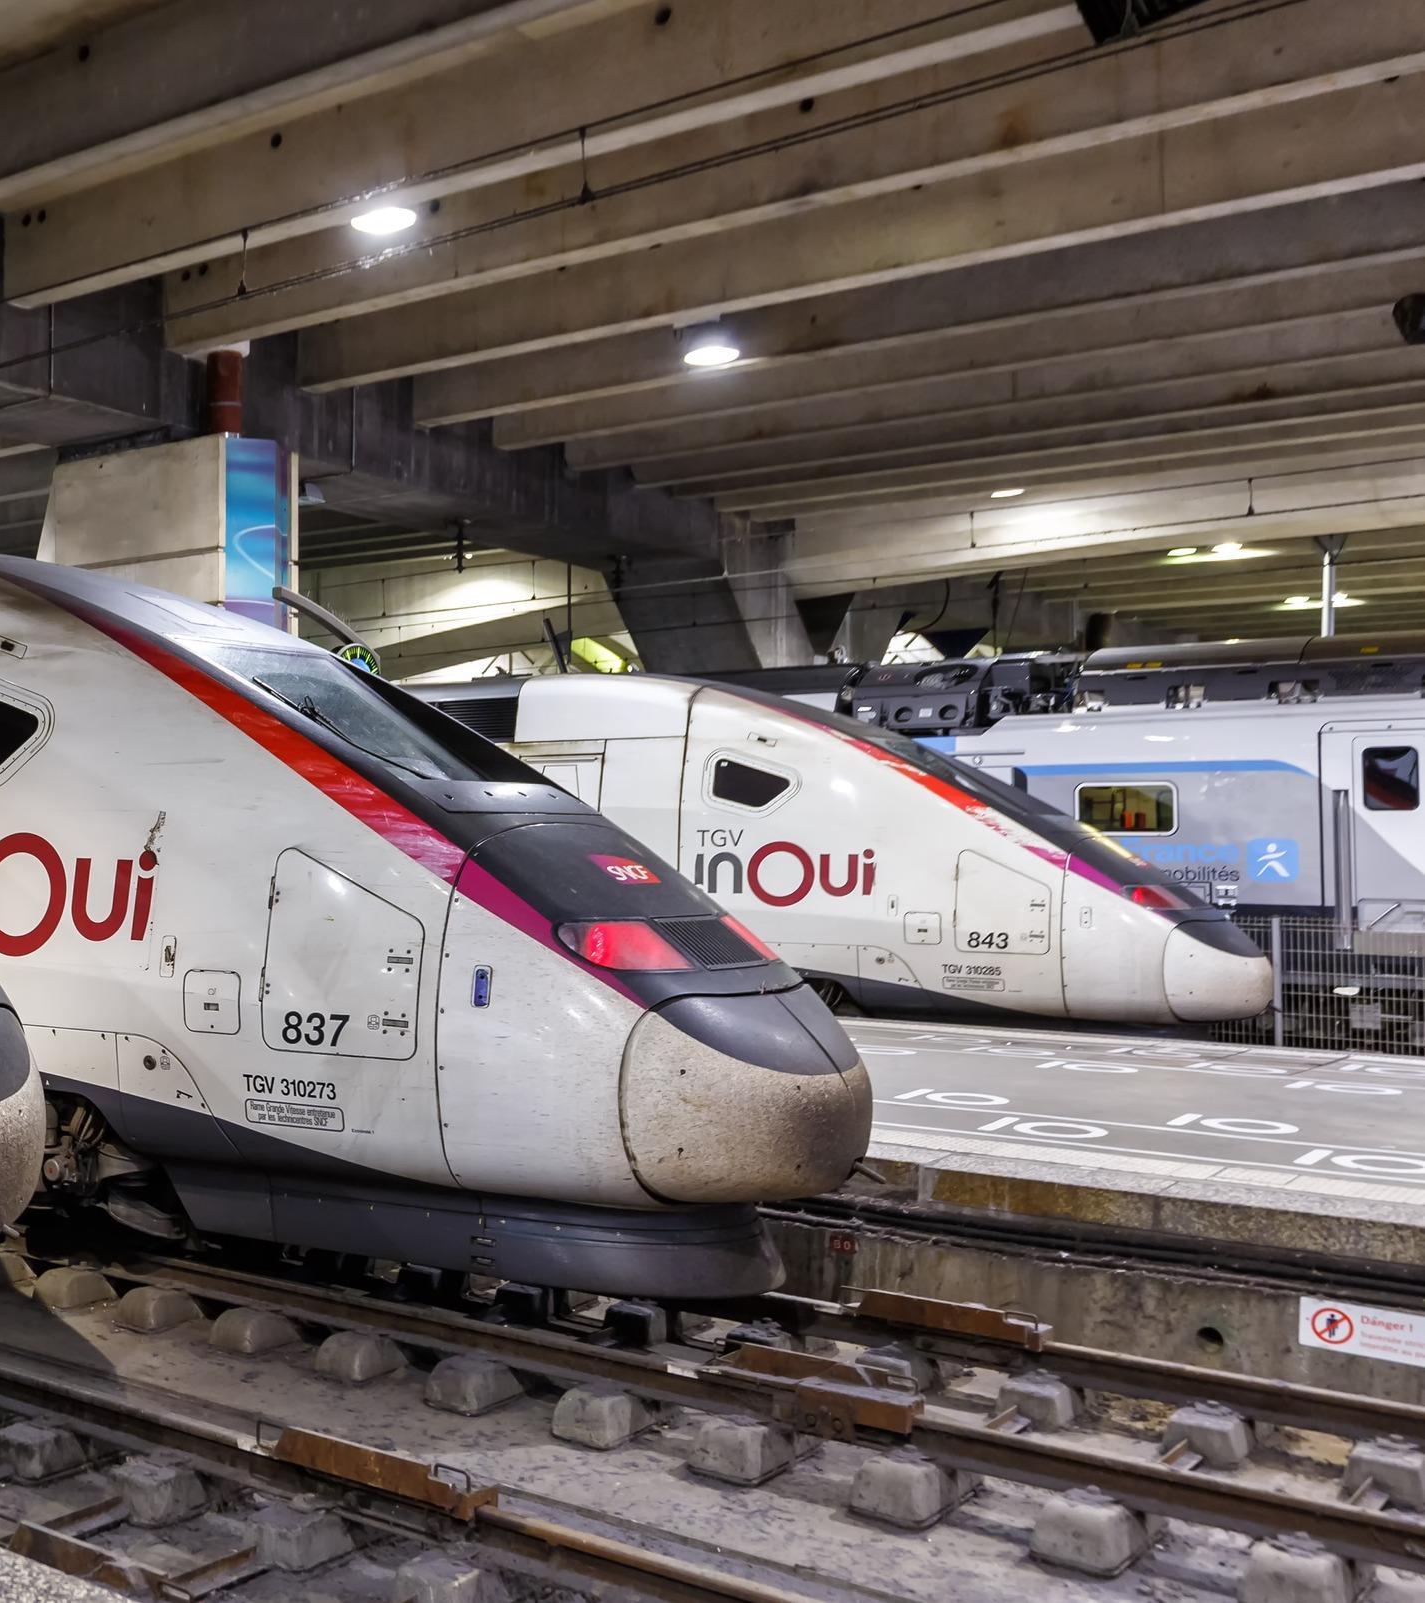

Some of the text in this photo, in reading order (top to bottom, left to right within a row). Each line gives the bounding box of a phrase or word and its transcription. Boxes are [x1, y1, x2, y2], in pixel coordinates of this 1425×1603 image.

[697, 829, 744, 847] TGV
[606, 865, 649, 881] SNCF
[967, 931, 1009, 949] 843
[941, 963, 963, 974] TGV
[281, 1011, 350, 1047] 837
[242, 1074, 337, 1100] TGV 310273
